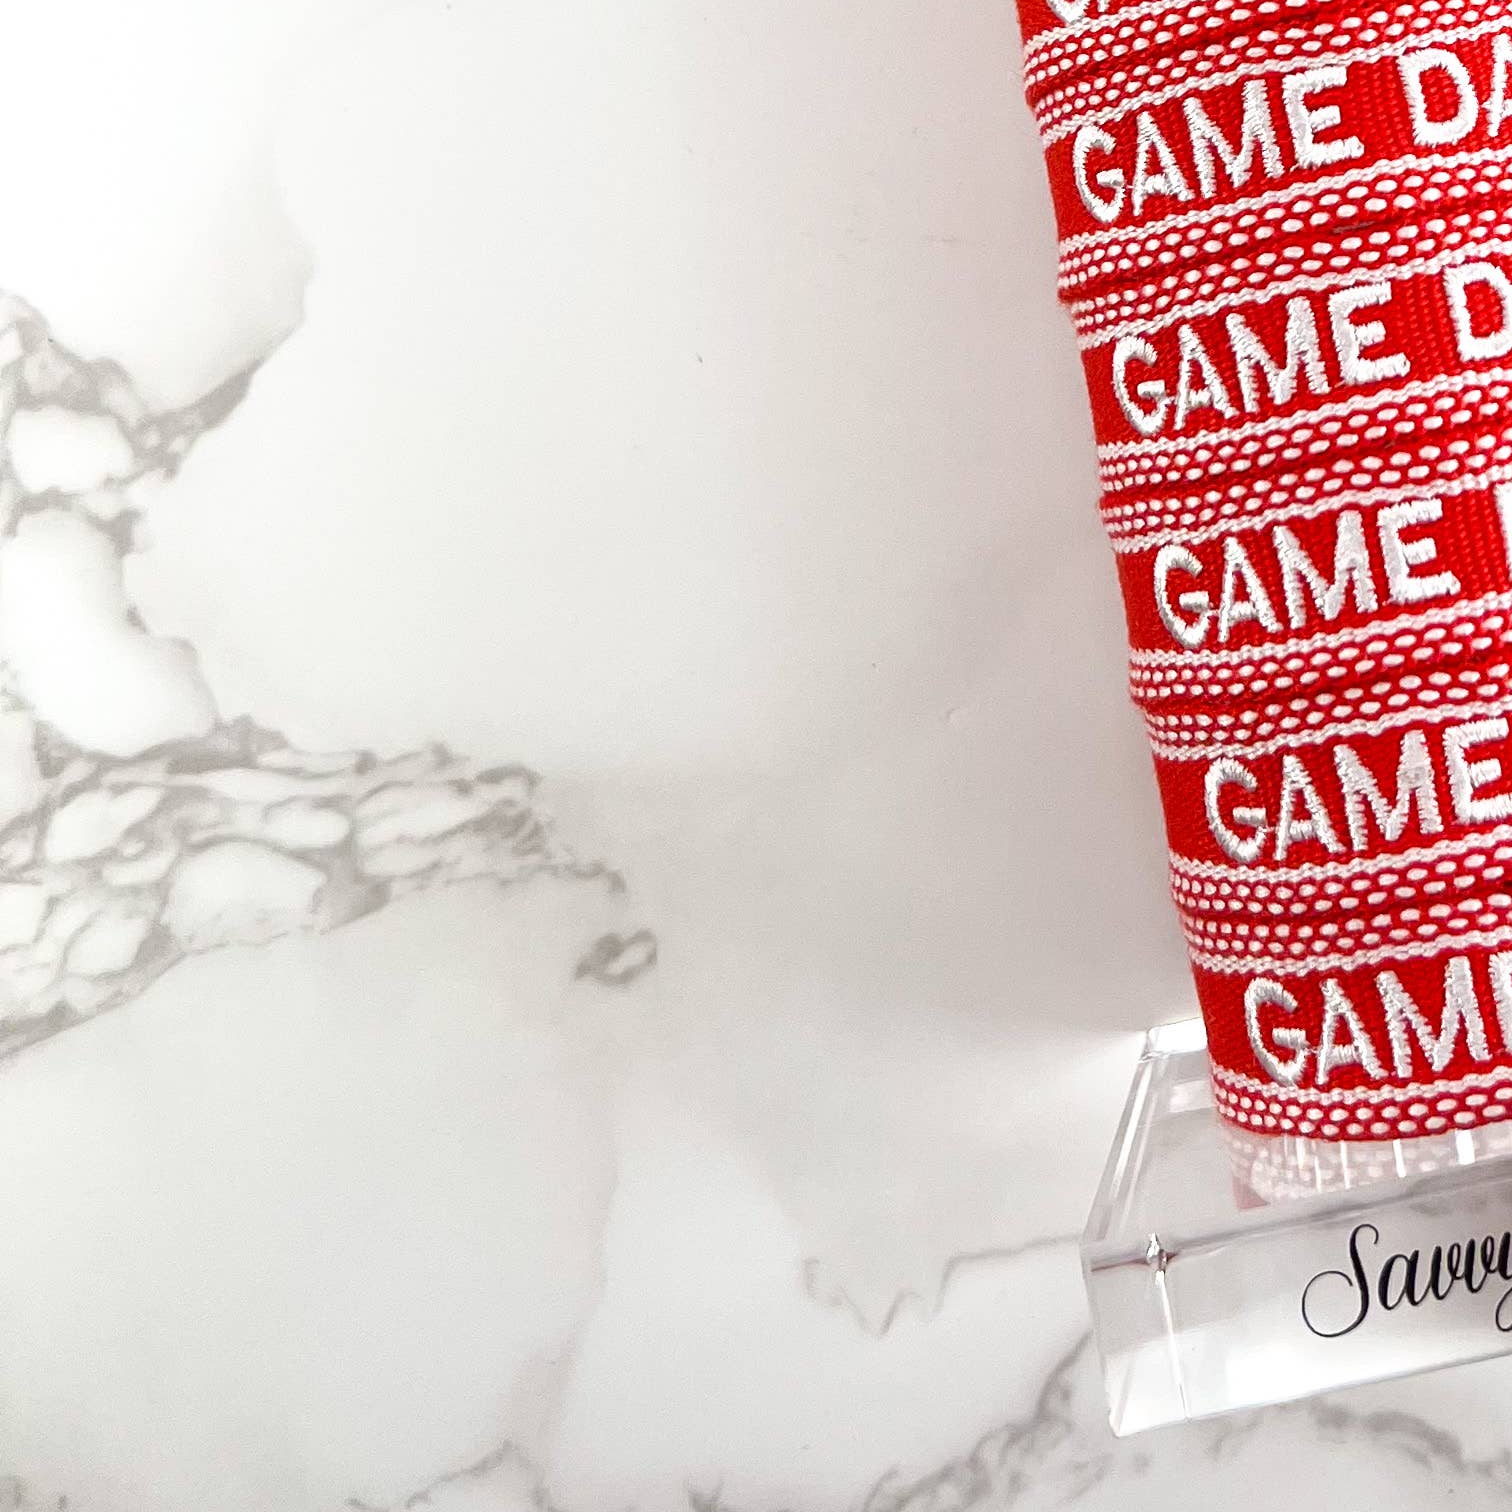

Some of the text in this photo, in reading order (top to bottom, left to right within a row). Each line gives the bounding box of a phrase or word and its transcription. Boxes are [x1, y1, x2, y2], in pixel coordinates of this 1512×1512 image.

[1072, 66, 1364, 223] GAME
[1112, 280, 1411, 436] GAME
[1153, 499, 1461, 649] GAME
